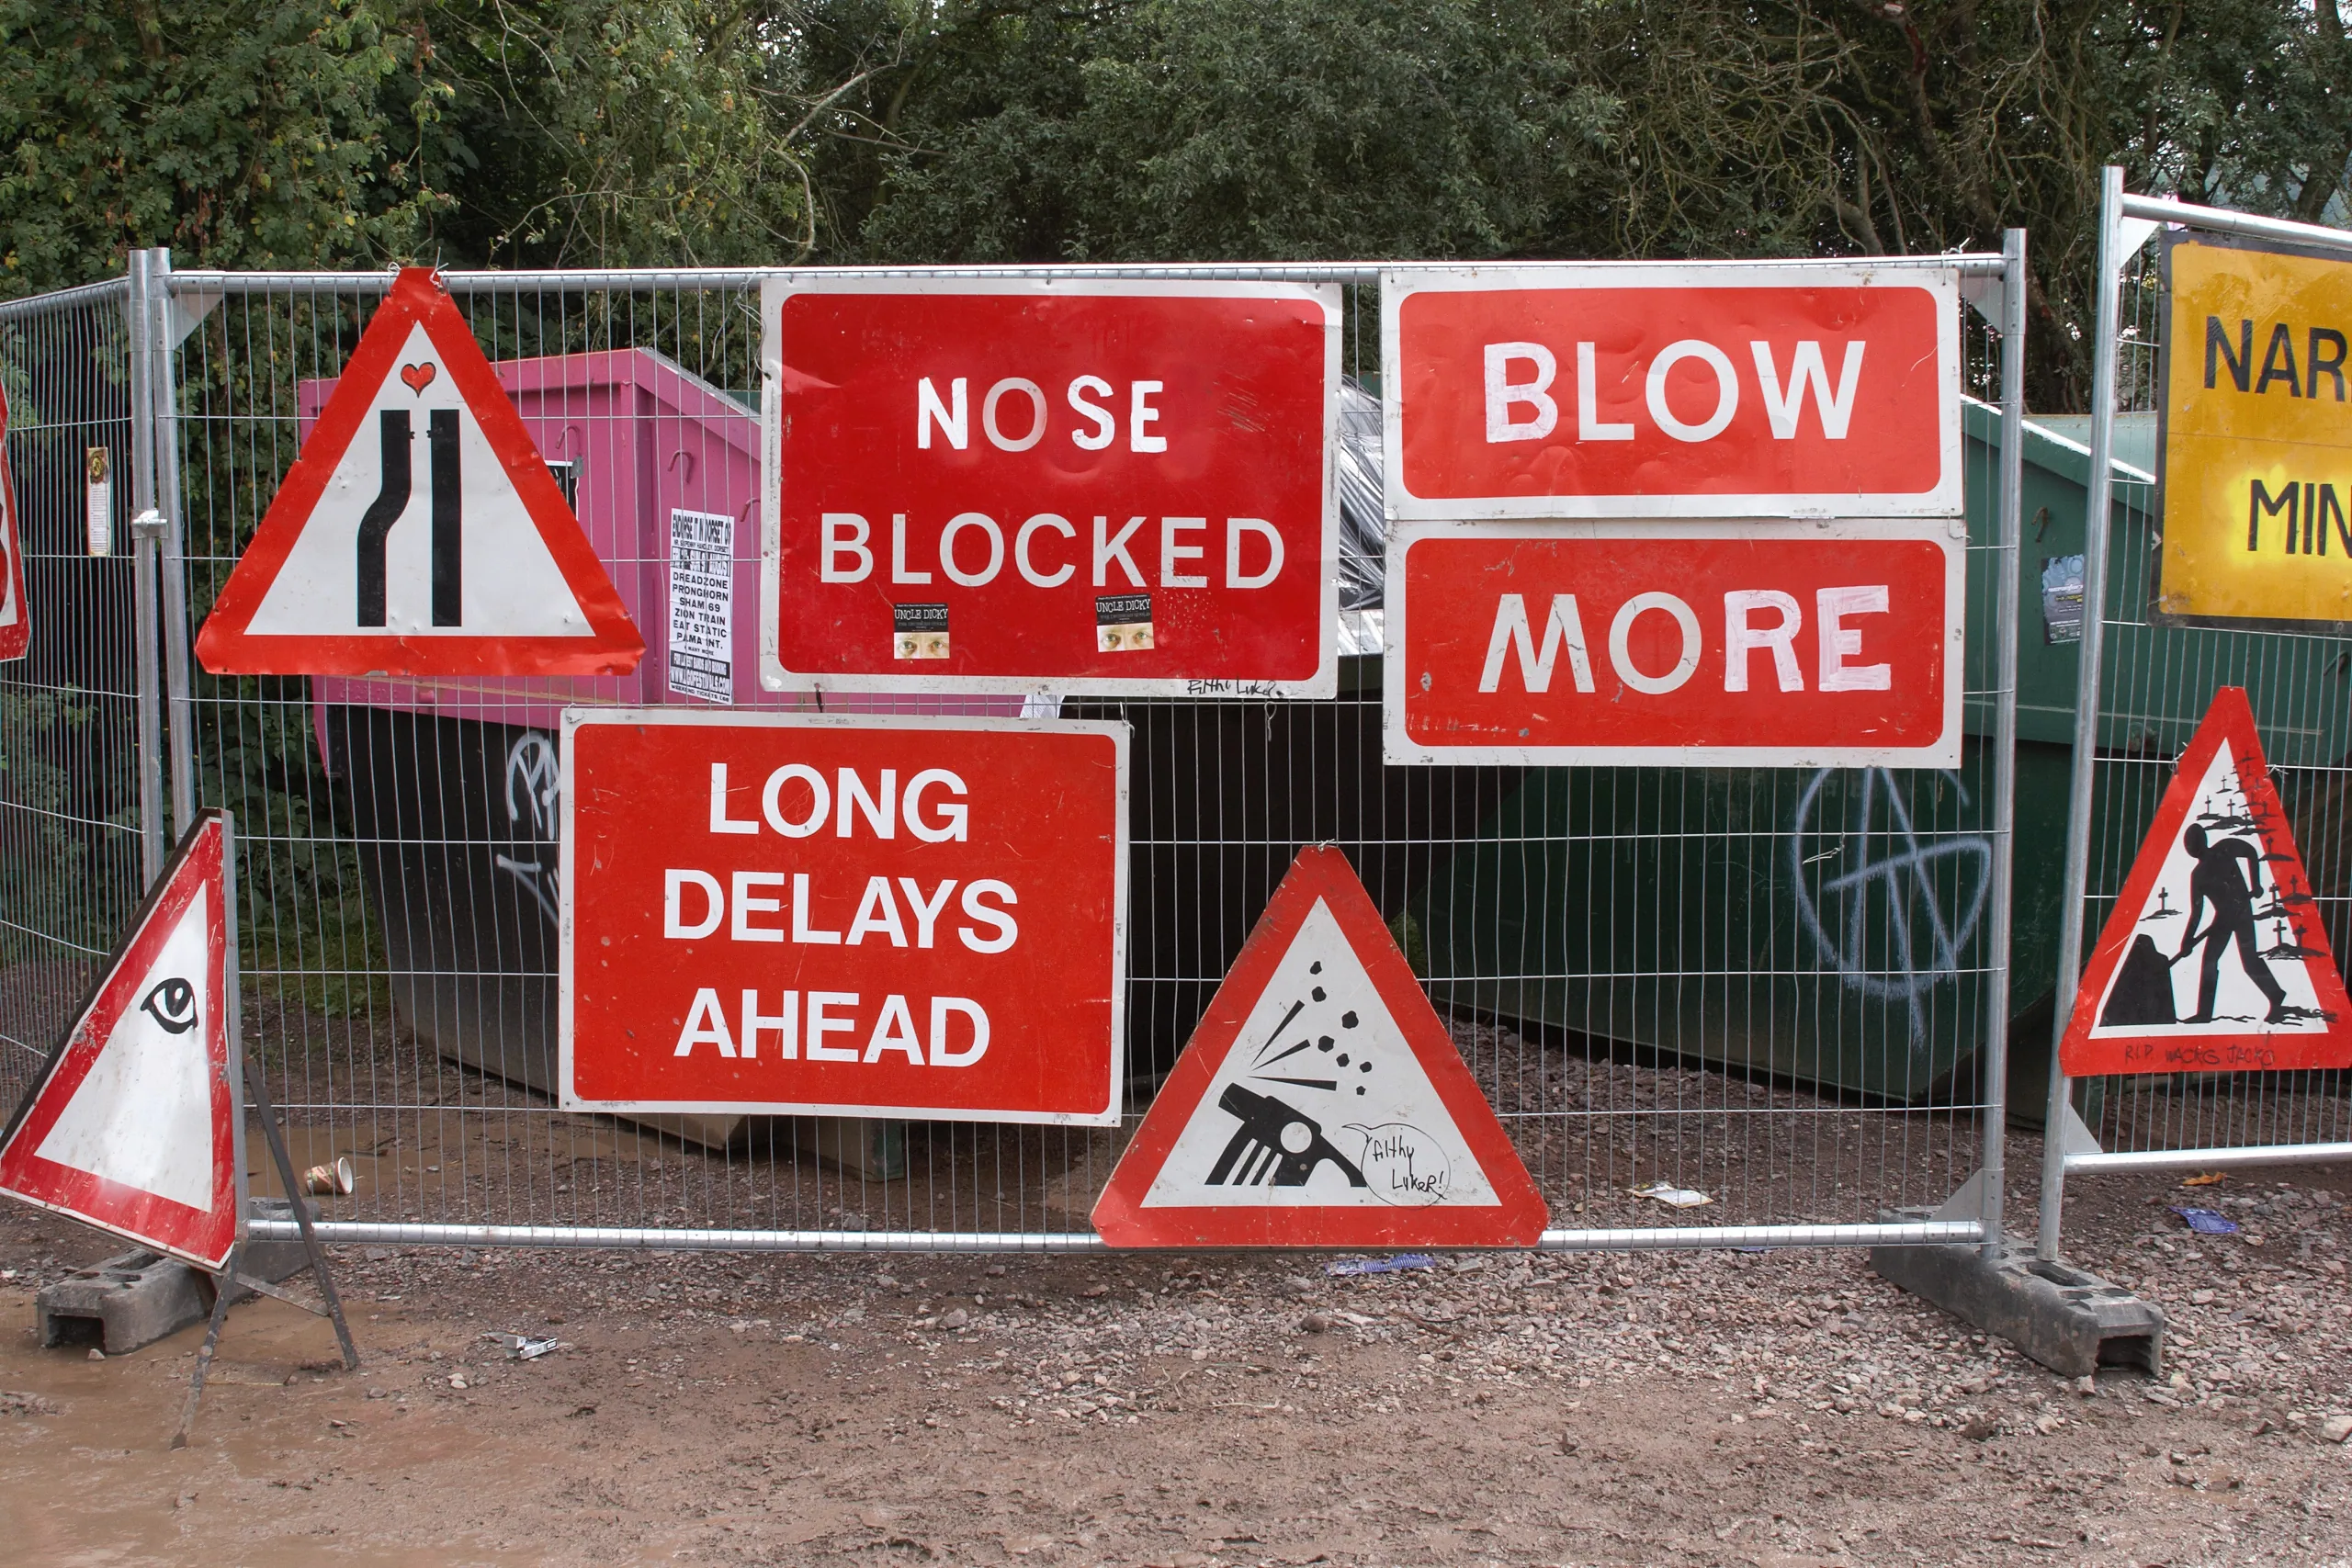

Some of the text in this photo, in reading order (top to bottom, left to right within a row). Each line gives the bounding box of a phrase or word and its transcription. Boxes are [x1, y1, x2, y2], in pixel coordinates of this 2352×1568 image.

[2203, 315, 2352, 405] NAR
[918, 375, 1168, 453] NOSE
[1484, 340, 1866, 443] BLOW
[821, 513, 1283, 588] BLOCKED
[673, 571, 729, 590] DREADZONE
[673, 583, 729, 602] PRONGHORN
[673, 619, 728, 637] EAT STATIC
[674, 608, 726, 626] ZION TRAIN
[680, 597, 720, 612] SHAM 69
[894, 608, 949, 621] UNCLE DICKY
[1095, 599, 1151, 614] UNCLE DICKY
[677, 632, 723, 649] PAMA INT.
[1478, 585, 1892, 694] MORE
[710, 763, 968, 842] LONG
[664, 869, 1019, 953] DELAYS
[673, 988, 990, 1067] AHEAD
